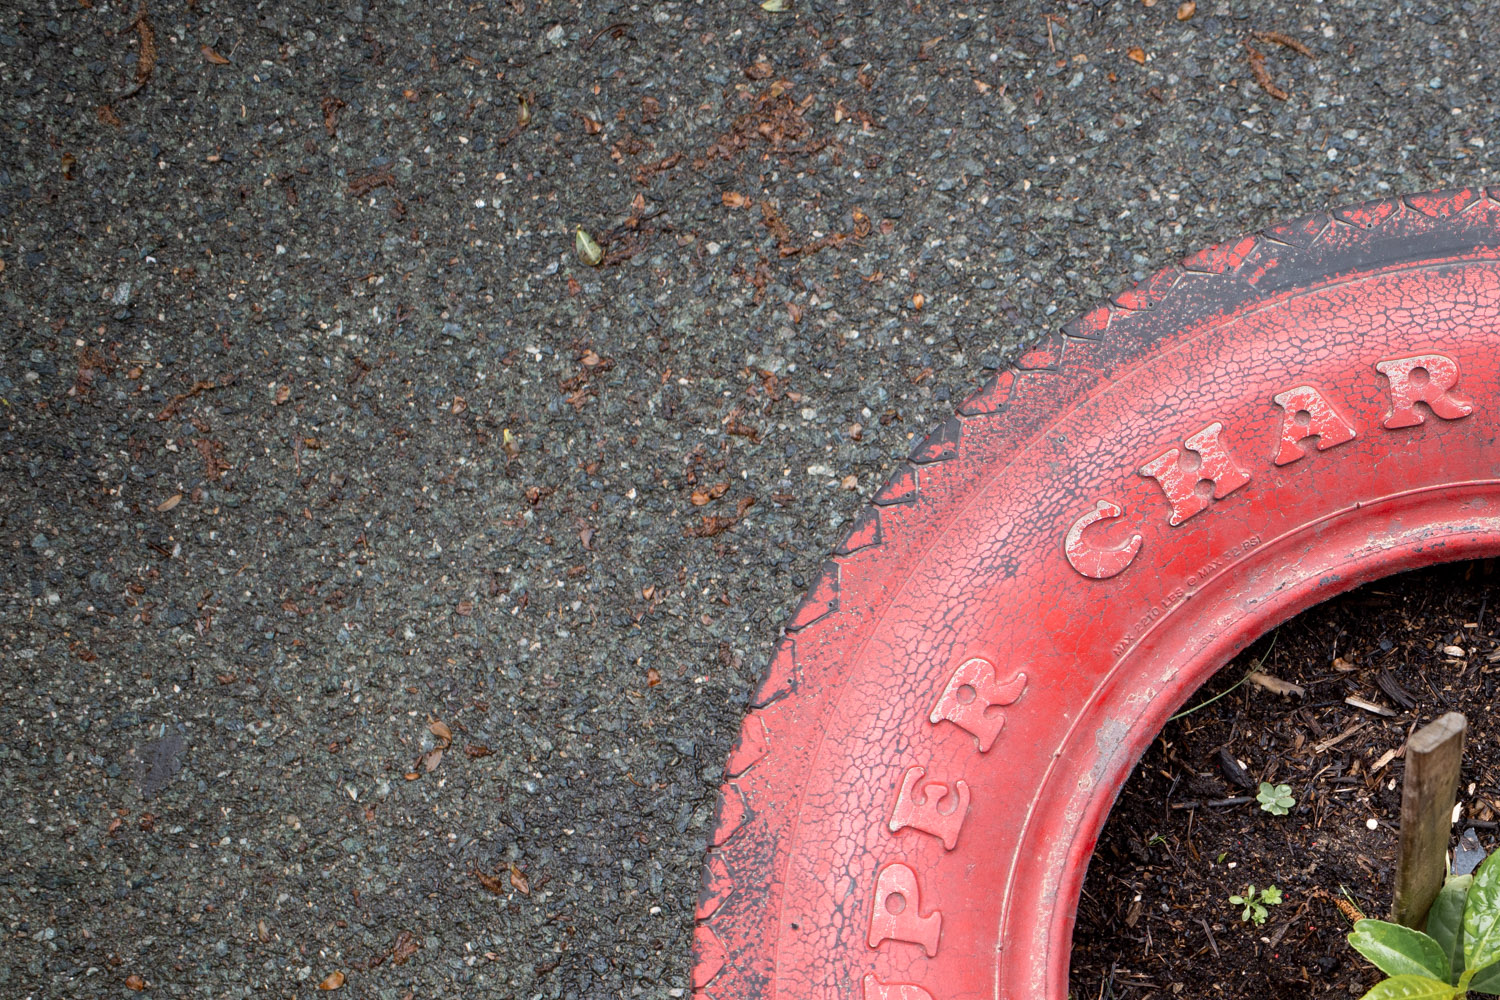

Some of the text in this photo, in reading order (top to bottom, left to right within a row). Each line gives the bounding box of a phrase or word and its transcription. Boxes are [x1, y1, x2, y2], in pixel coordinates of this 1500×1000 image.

[1111, 632, 1134, 656] MAX
[1133, 606, 1160, 633] 2210
[1161, 587, 1183, 608] LBS
[1185, 576, 1197, 587] @
[1198, 558, 1221, 578] MAX
[1241, 535, 1261, 550] PSI
